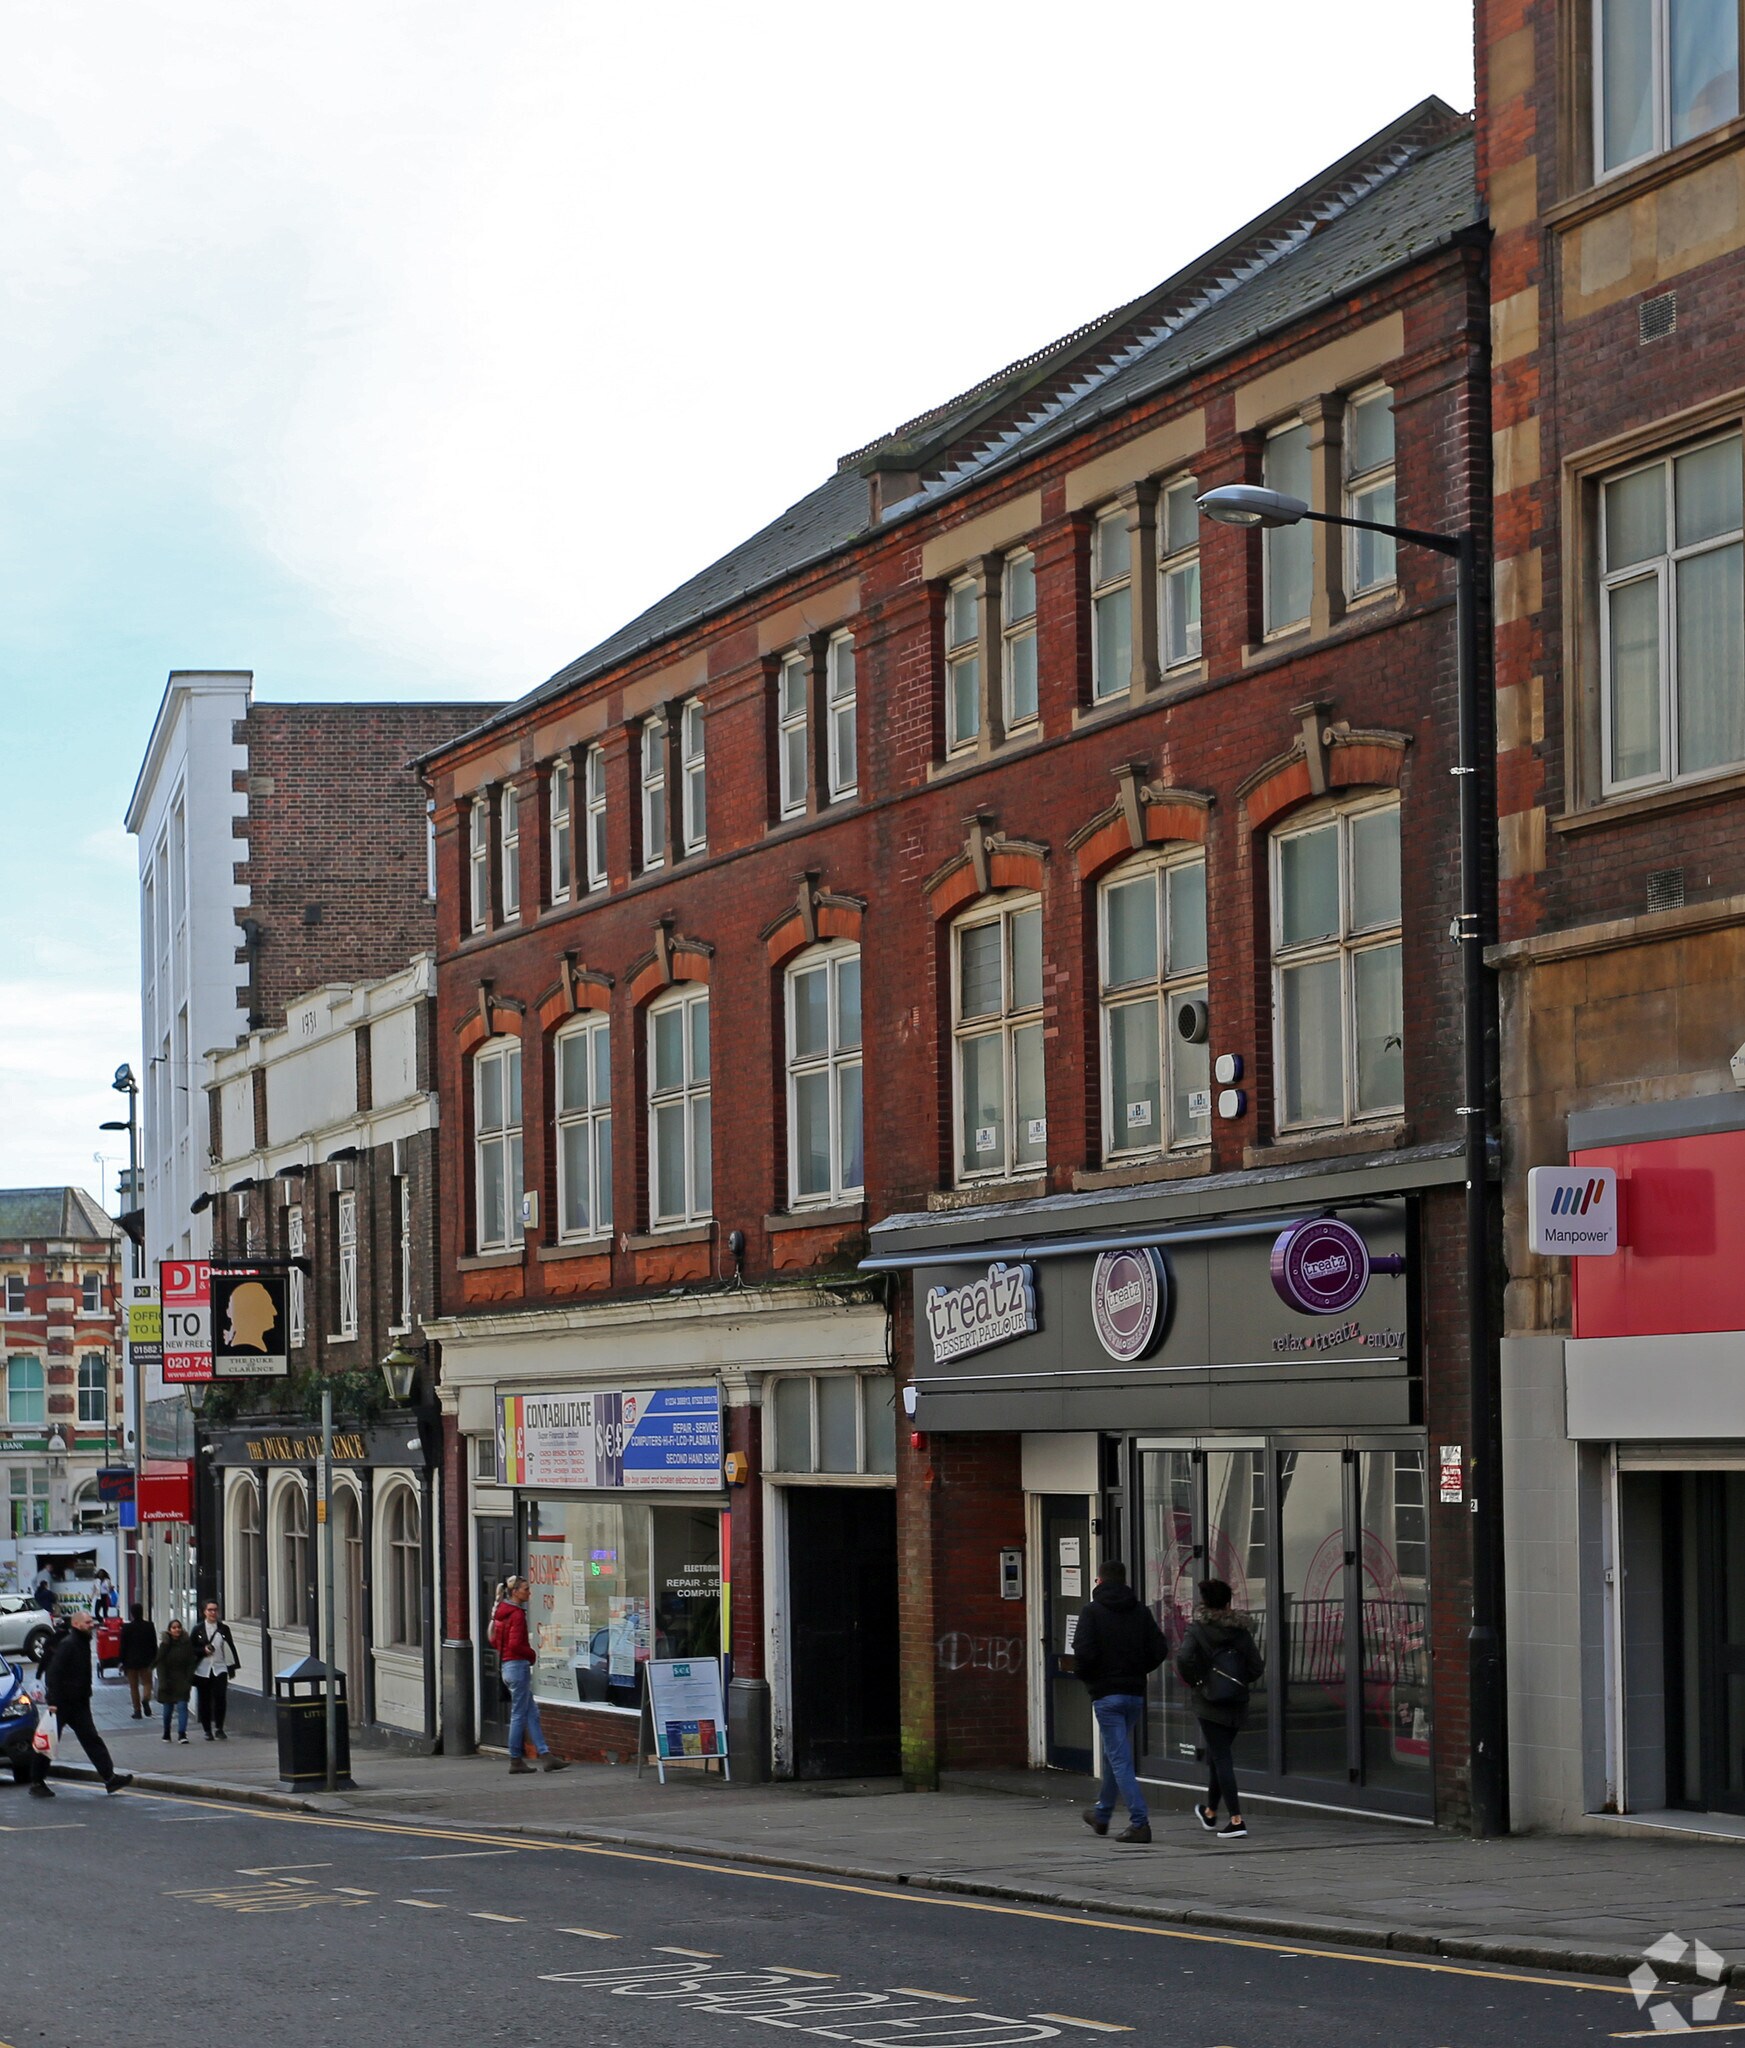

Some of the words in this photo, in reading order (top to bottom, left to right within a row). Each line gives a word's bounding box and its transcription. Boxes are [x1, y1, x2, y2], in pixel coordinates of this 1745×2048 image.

[302, 1011, 317, 1035] 1931
[1545, 1228, 1608, 1244] Manpower
[1304, 1256, 1345, 1275] treatz
[1107, 1281, 1140, 1307] treatz
[929, 1270, 1023, 1340] treatz
[134, 1325, 149, 1334] TO
[168, 1313, 201, 1337] TO
[166, 1340, 183, 1349] NEW
[185, 1340, 203, 1348] FREE
[935, 1329, 979, 1359] DESSERT
[979, 1312, 1026, 1345] PARLOUR
[1272, 1333, 1304, 1352] relax
[1315, 1322, 1360, 1352] treatz
[1367, 1328, 1405, 1349] enjoy
[167, 1357, 190, 1369] 020
[526, 1401, 591, 1429] CONTABILITATE
[672, 1423, 692, 1433] REPAIR
[695, 1422, 719, 1433] SERVICE
[3, 1442, 24, 1450] BANK
[246, 1441, 264, 1460] THE
[263, 1436, 292, 1460] DUKE
[293, 1440, 305, 1459] OF
[666, 1453, 688, 1464] SECOND
[688, 1453, 703, 1464] HAND
[703, 1453, 719, 1464] SHOP
[143, 1511, 184, 1519] Ladbrokes
[529, 1554, 572, 1587] BUSINESS
[666, 1579, 700, 1587] REPAIR
[543, 1594, 555, 1611] FOR
[537, 1962, 1062, 2048] DISABLED
